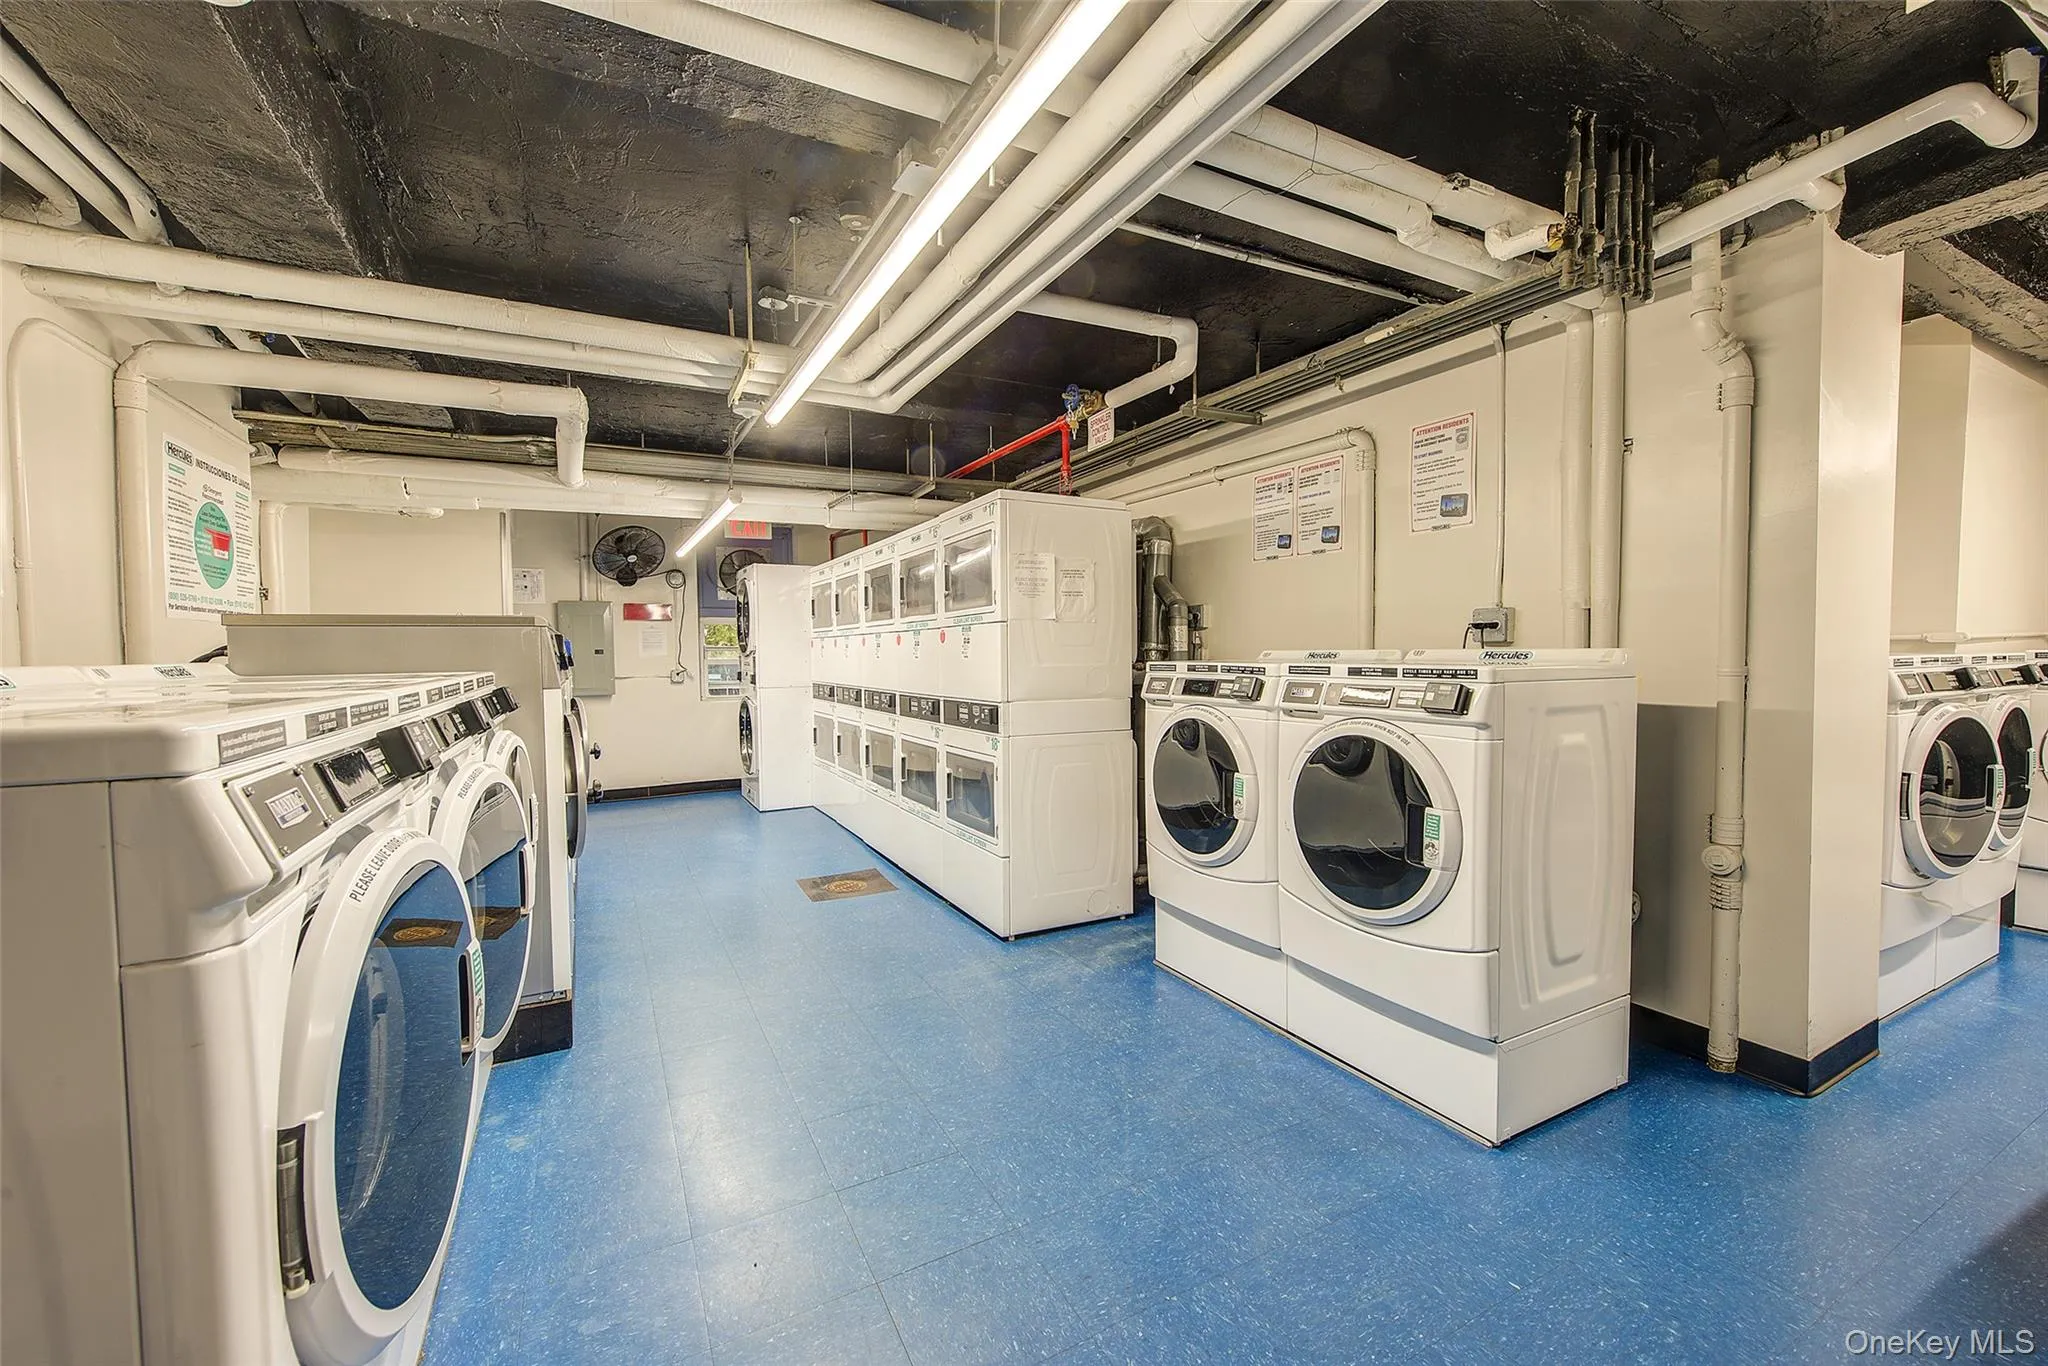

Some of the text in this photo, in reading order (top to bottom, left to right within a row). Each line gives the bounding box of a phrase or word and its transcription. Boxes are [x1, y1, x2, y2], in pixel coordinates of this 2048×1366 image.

[1416, 418, 1469, 436] ATTENTION RESIDENTS
[167, 442, 193, 464] Hercules
[195, 458, 231, 481] INSTRUCCIONES
[232, 473, 237, 484] DE
[1301, 460, 1340, 473] ATTENTION RESIDENTS
[1257, 471, 1291, 484] ATTENTION RESIDENTS
[731, 520, 766, 537] EXIT
[1483, 650, 1529, 660] Hercules
[1374, 724, 1387, 732] WHEN
[1387, 727, 1397, 736] NOT
[1401, 737, 1411, 746] USE
[458, 783, 472, 799] PLEASE
[468, 772, 479, 784] LEAVE
[349, 868, 377, 902] PLEASE
[368, 848, 392, 871] LEAVE
[384, 837, 402, 853] DOOR
